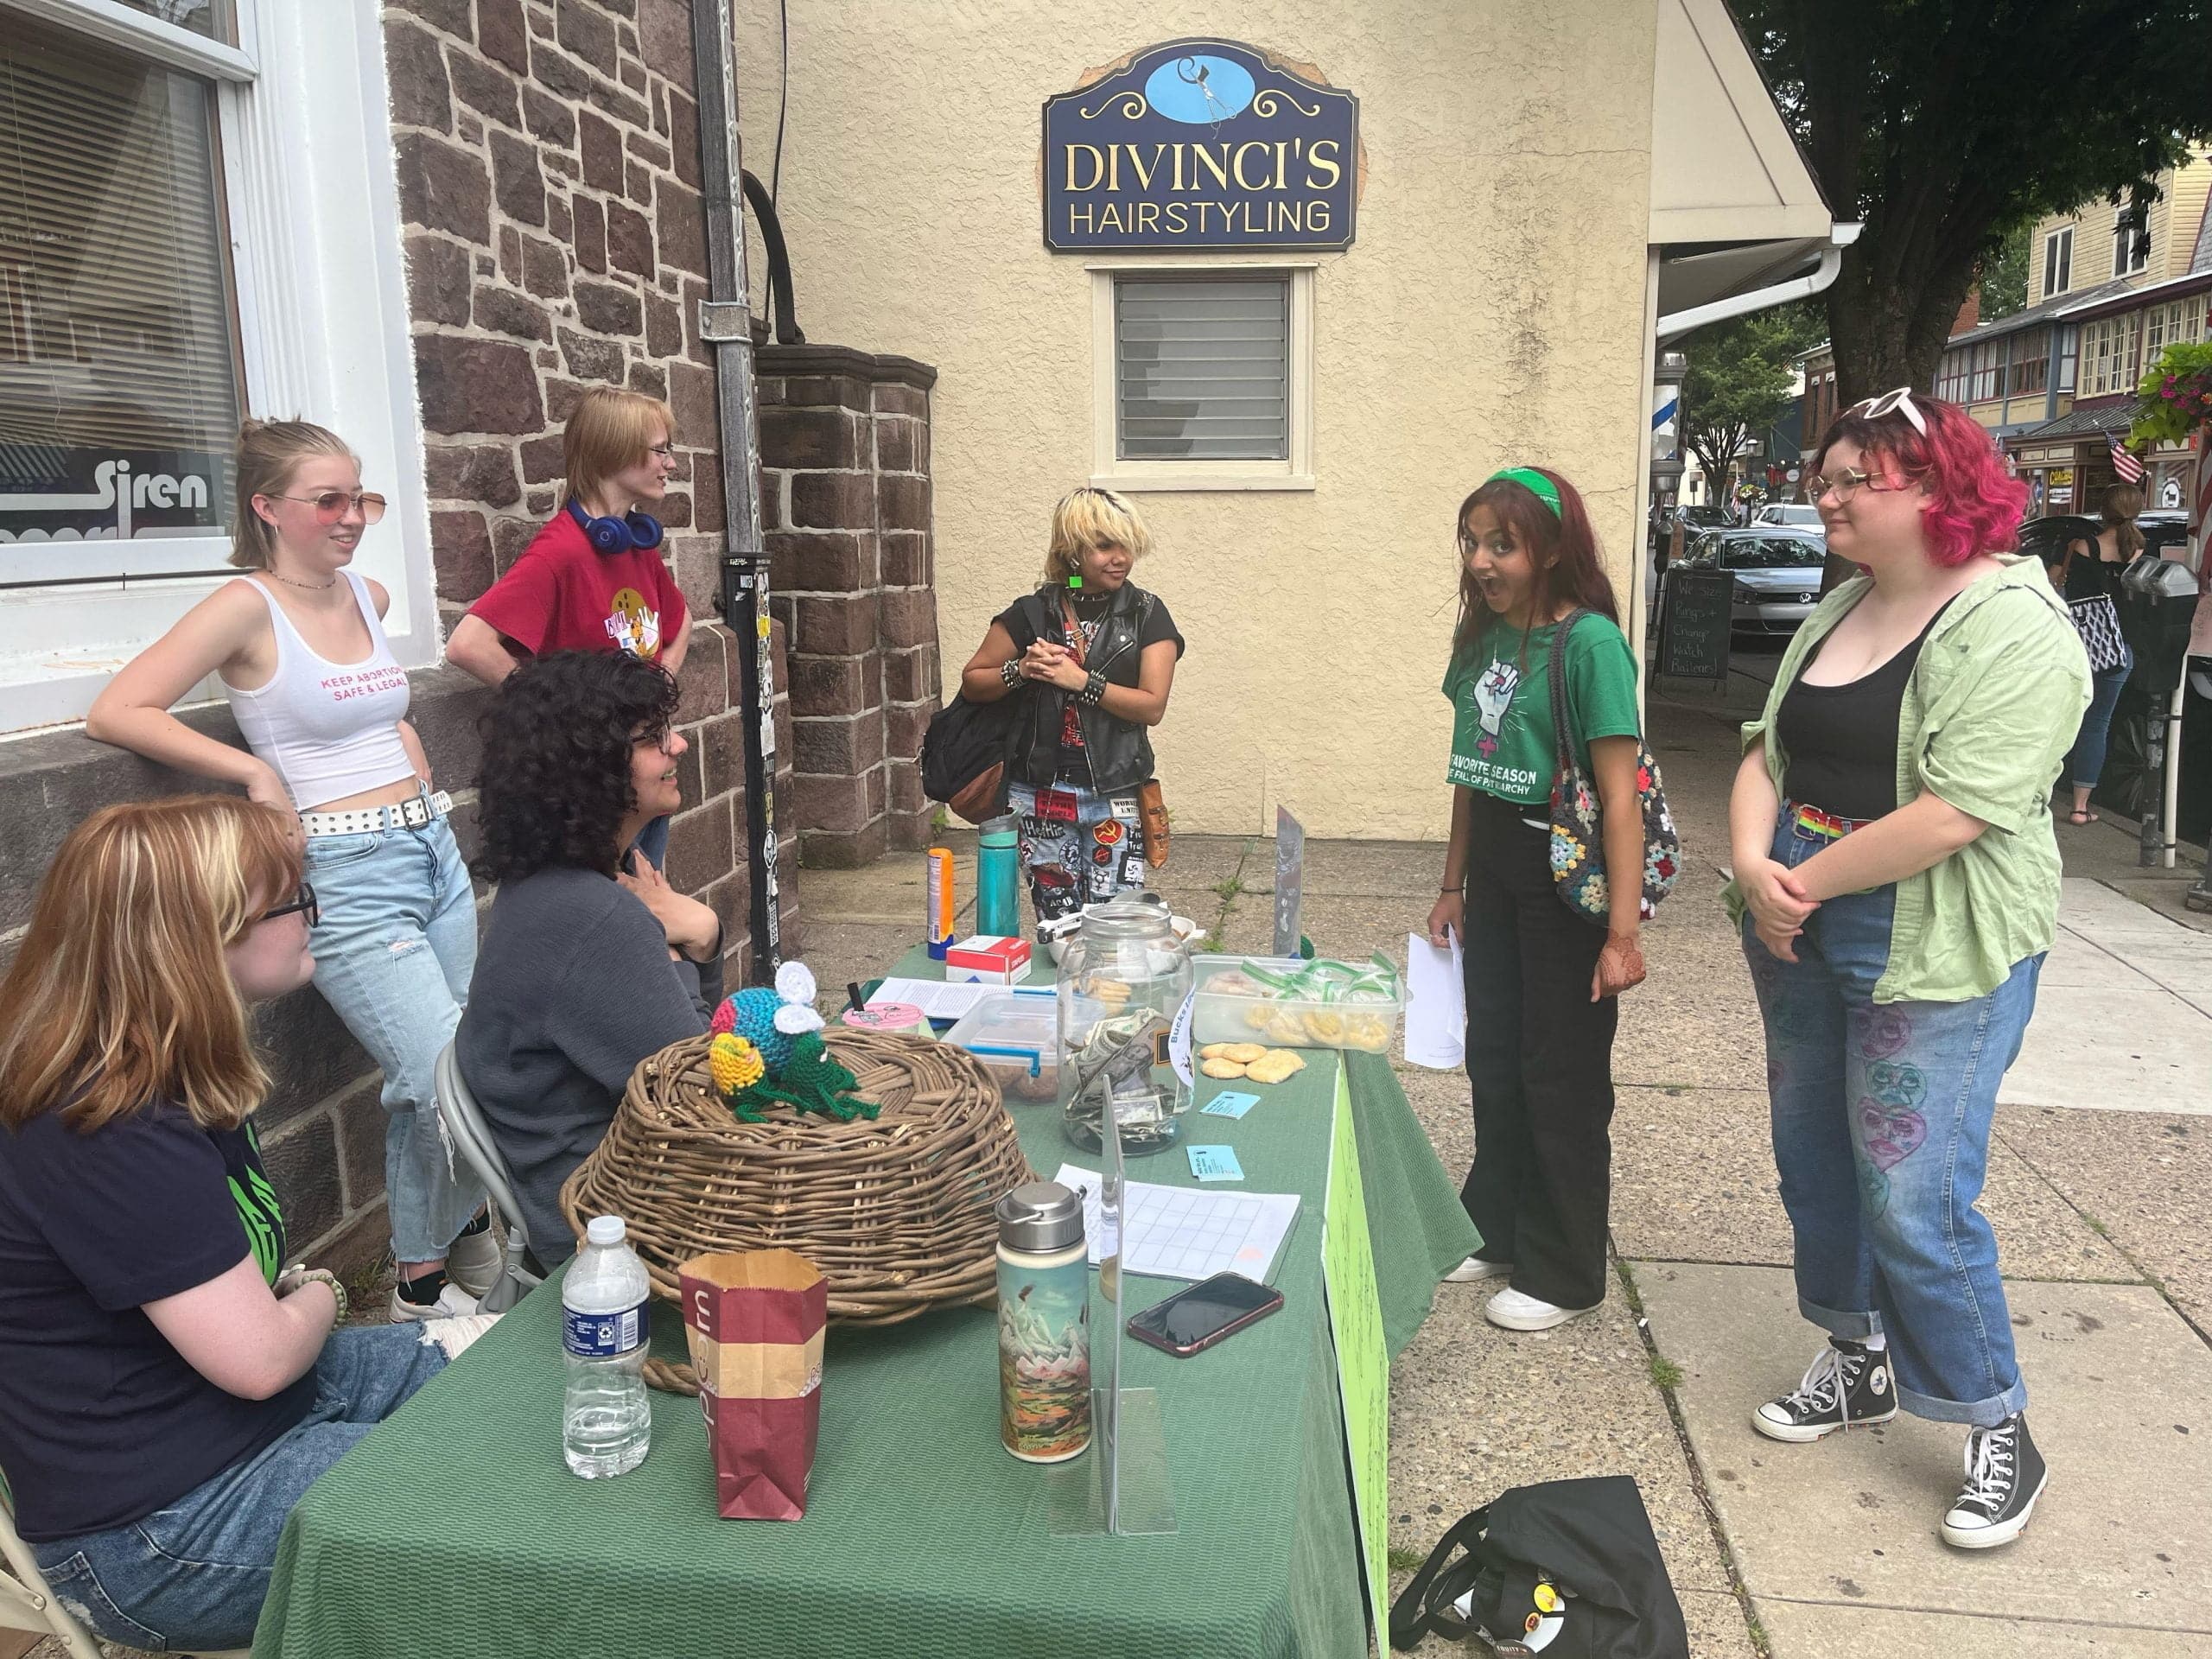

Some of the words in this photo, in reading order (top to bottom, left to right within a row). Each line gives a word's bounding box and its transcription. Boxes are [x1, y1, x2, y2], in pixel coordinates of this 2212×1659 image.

[1064, 137, 1340, 192] DIVINCI'S
[1069, 200, 1331, 234] HAIRSTYLING
[94, 459, 207, 512] Siren
[321, 676, 353, 689] KEEP
[334, 686, 365, 701] SAFE
[367, 684, 374, 693] &
[376, 677, 407, 691] LEGAL
[1454, 770, 1469, 782] FALL
[1471, 775, 1483, 784] OF
[1491, 765, 1536, 785] SEASON
[1171, 1009, 1186, 1043] Bucks
